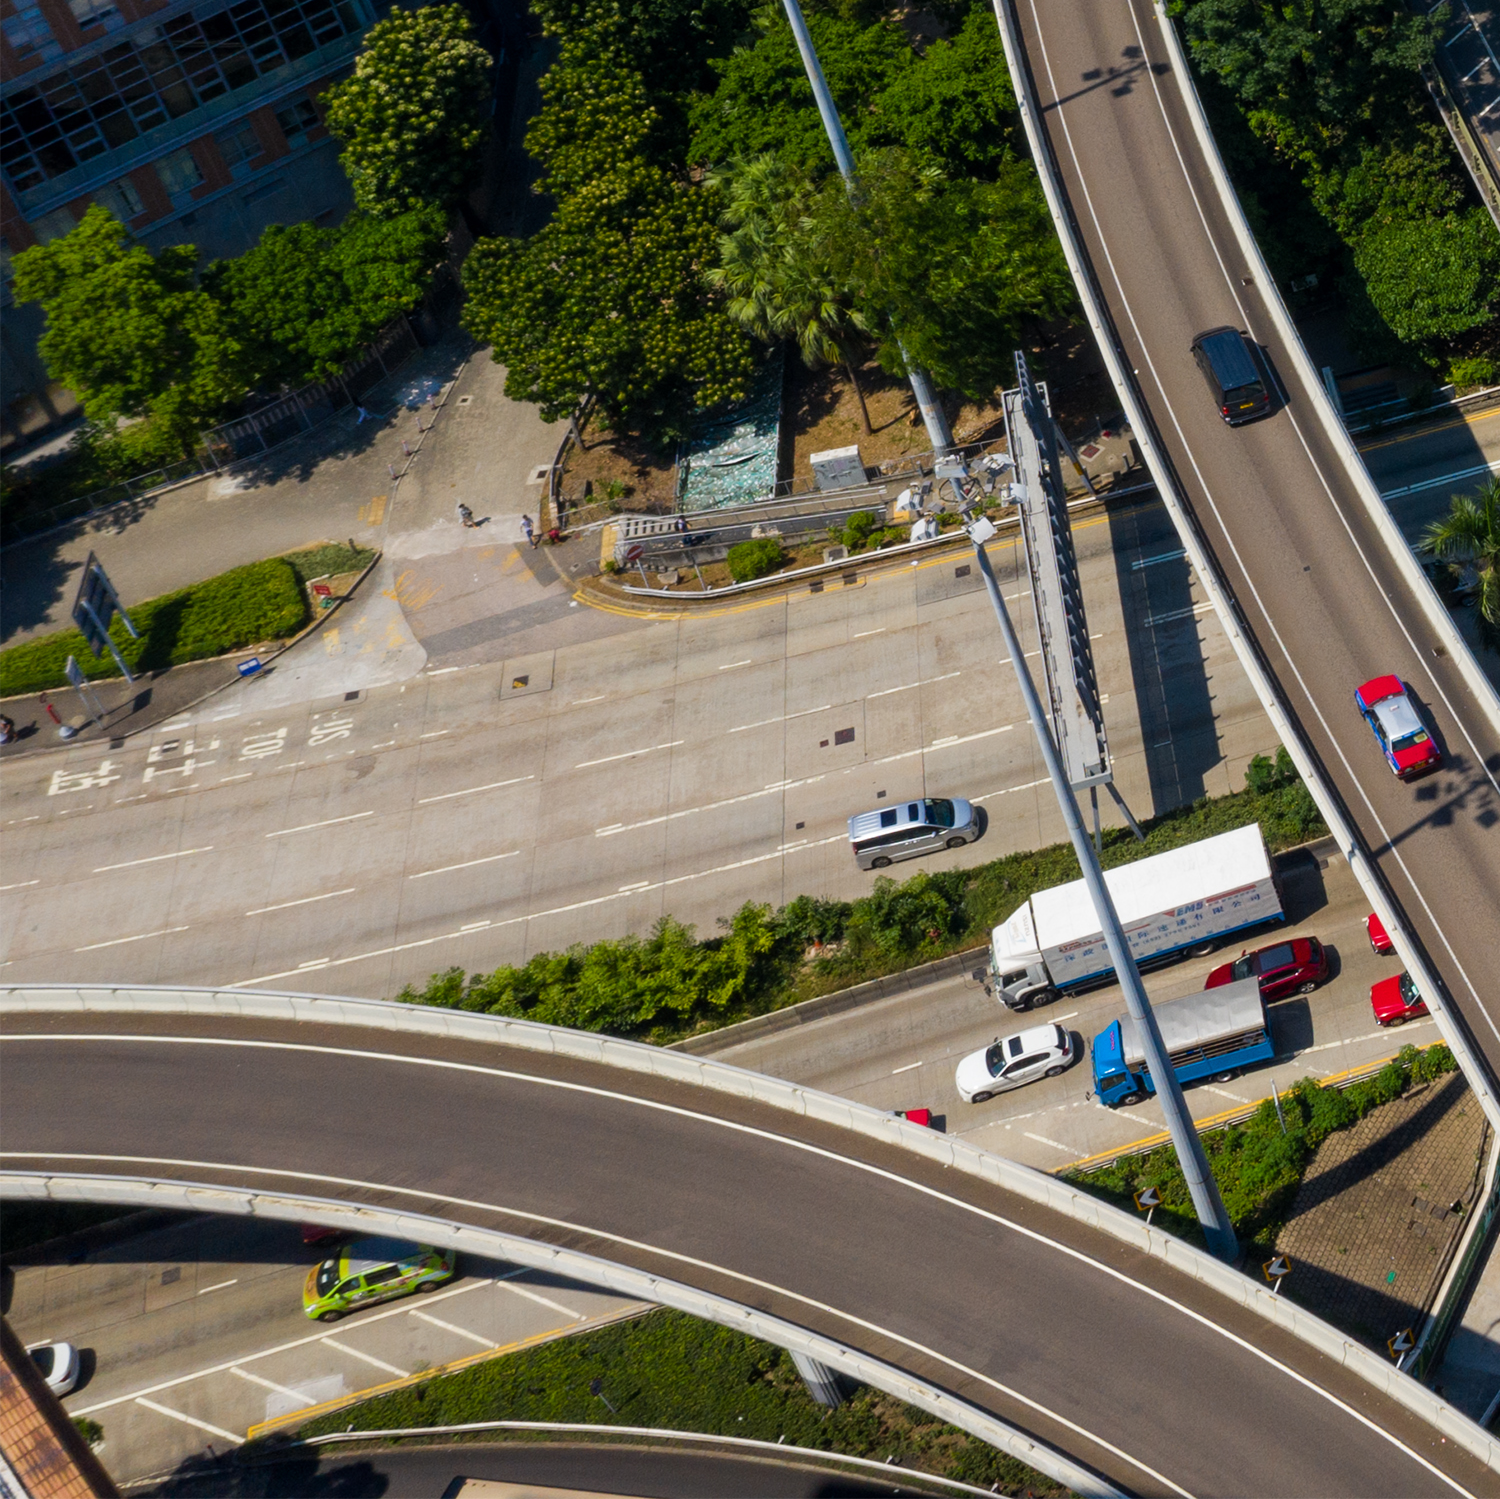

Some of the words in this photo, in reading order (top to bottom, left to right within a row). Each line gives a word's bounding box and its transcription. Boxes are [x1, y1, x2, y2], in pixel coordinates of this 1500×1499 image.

[308, 713, 354, 748] US
[1175, 901, 1204, 918] EMS
[1021, 914, 1031, 938] ISUZU
